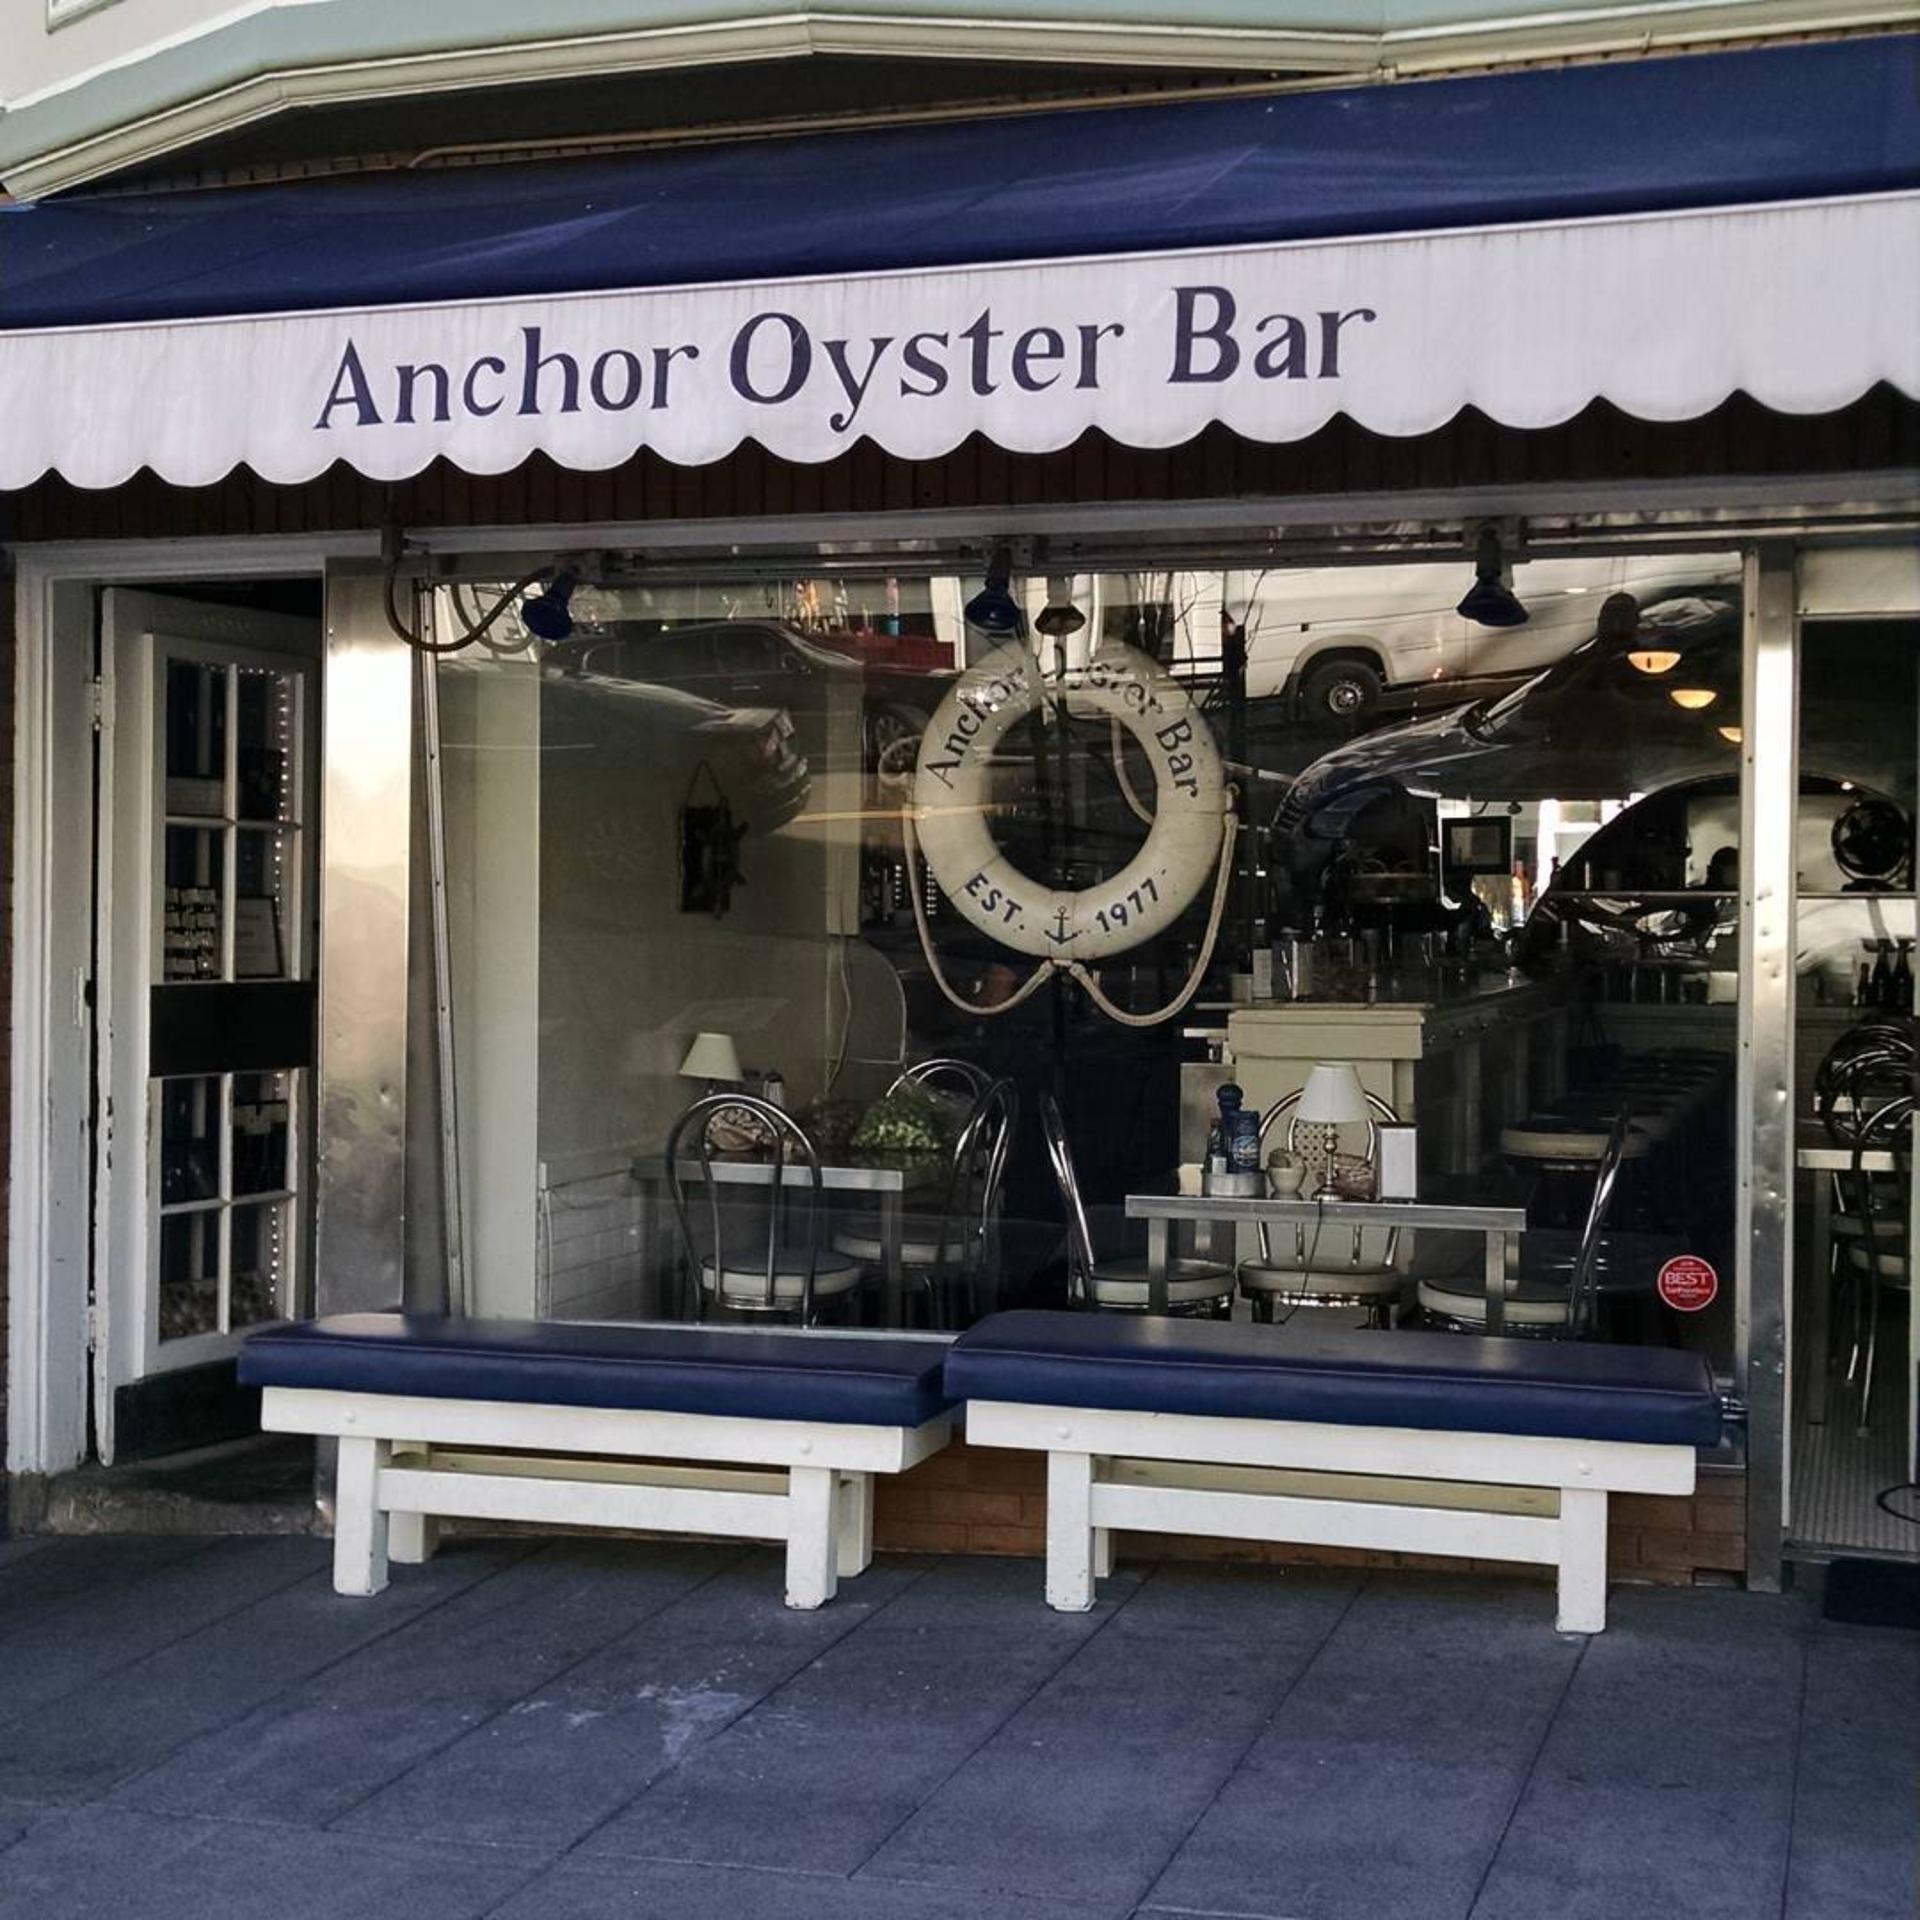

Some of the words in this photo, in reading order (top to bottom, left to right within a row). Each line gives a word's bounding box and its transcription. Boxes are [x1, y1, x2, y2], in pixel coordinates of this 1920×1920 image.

[315, 326, 700, 430] Anchor
[730, 309, 1125, 433] Oyster
[1168, 285, 1377, 382] Bar
[1155, 717, 1199, 799] Bar
[964, 872, 1026, 931] EST.
[1095, 878, 1160, 933] 1977
[1664, 1272, 1709, 1286] BEST
